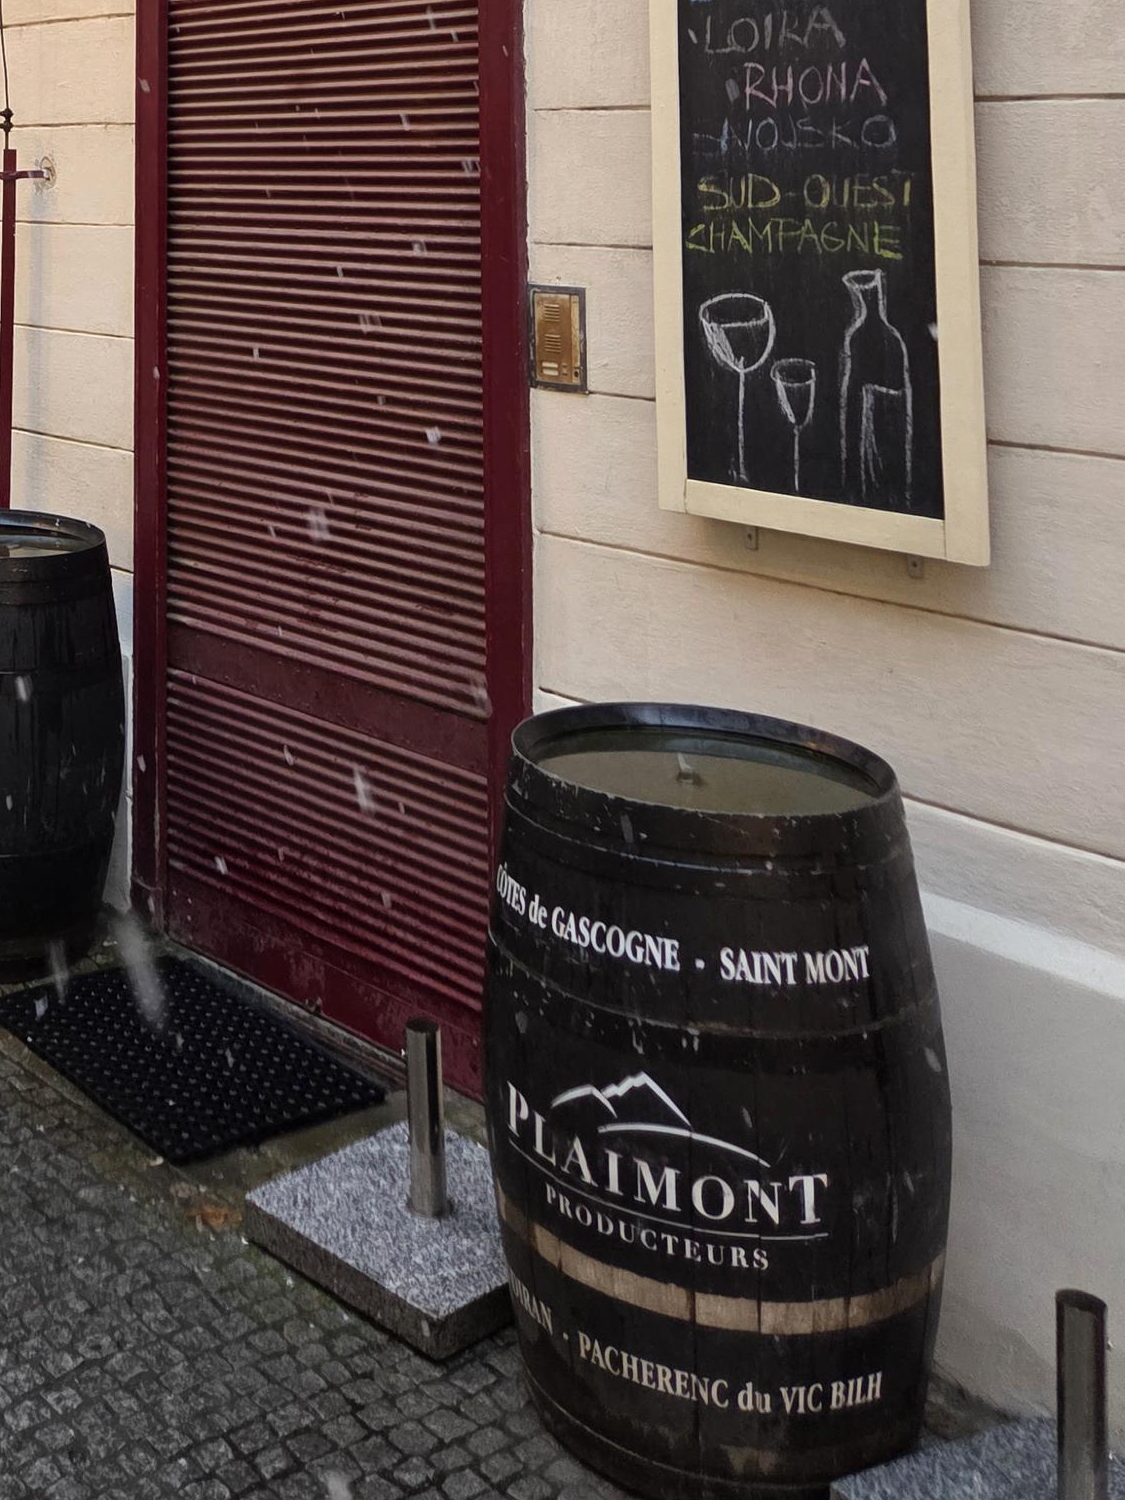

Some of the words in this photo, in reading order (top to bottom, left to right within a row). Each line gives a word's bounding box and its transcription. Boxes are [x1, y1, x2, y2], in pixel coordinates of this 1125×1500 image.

[743, 57, 888, 112] RHONA
[686, 217, 903, 260] CHAMPAGNE
[496, 861, 527, 917] CÔTES
[528, 893, 548, 929] de
[550, 905, 681, 972] GASCOGNE
[719, 946, 799, 986] SAINT
[802, 942, 870, 985] MONT
[506, 1080, 829, 1226] PLAIMONT
[545, 1182, 770, 1271] PRODUCTEURS
[577, 1329, 730, 1409] PACHERENC
[737, 1381, 772, 1414] du
[779, 1382, 824, 1415] VIC
[829, 1370, 883, 1411] BILH
